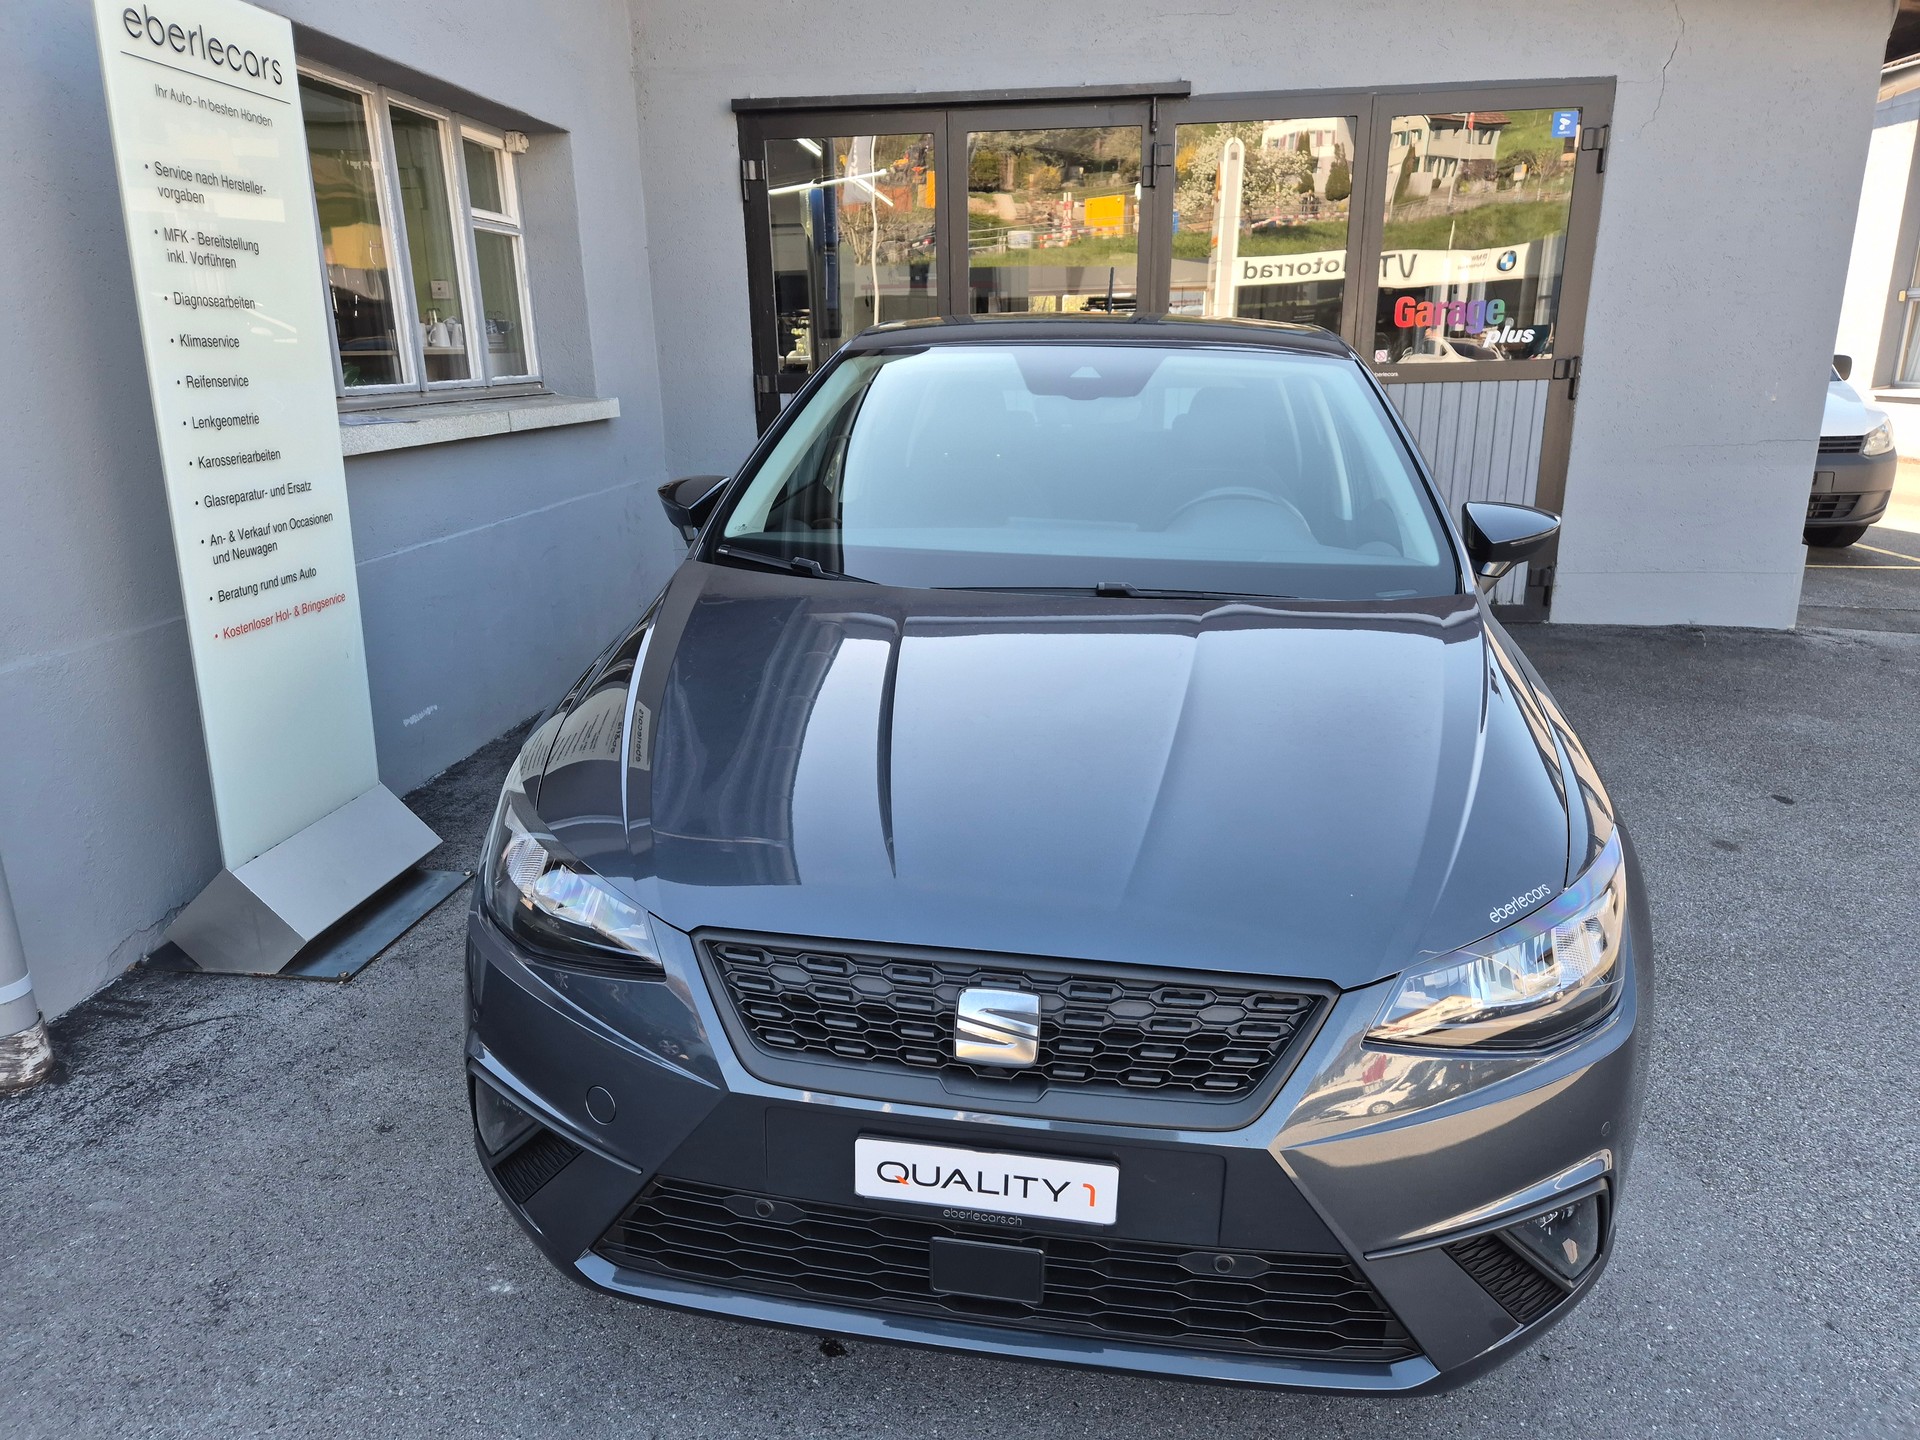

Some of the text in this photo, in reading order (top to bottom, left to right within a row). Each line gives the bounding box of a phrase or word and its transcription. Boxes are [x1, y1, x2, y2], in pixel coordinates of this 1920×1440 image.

[123, 4, 283, 86] eberlecars
[155, 83, 168, 99] Ihr
[208, 98, 240, 118] besten
[154, 160, 267, 195] Service nach Hersteller-
[158, 185, 205, 204] vorgaben
[164, 227, 190, 243] MFK
[197, 231, 260, 256] Bereitstellung
[166, 248, 237, 268] inkl. Vorführen
[173, 291, 256, 310] Diagnosearbeiten
[1394, 296, 1506, 334] Garage
[179, 333, 240, 348] Klimaservice
[1482, 325, 1536, 348] plus
[186, 374, 249, 388] Reifenservice
[192, 412, 260, 431] Lenkgeometrie
[198, 449, 281, 469] Karosseriearbeiten
[203, 480, 313, 508] Glasreparatur- und Ersatz
[210, 512, 334, 547] An- & Verkauf von Occasionen
[212, 541, 278, 565] und Neuwagen
[218, 566, 317, 603] Beratung rund ums Auto
[223, 592, 346, 640] Kostenloser Hol- & Bringservice
[1489, 883, 1551, 923] eberlecars
[876, 1161, 1072, 1202] QUALITY
[943, 1207, 1023, 1226] eberlecars.ch
